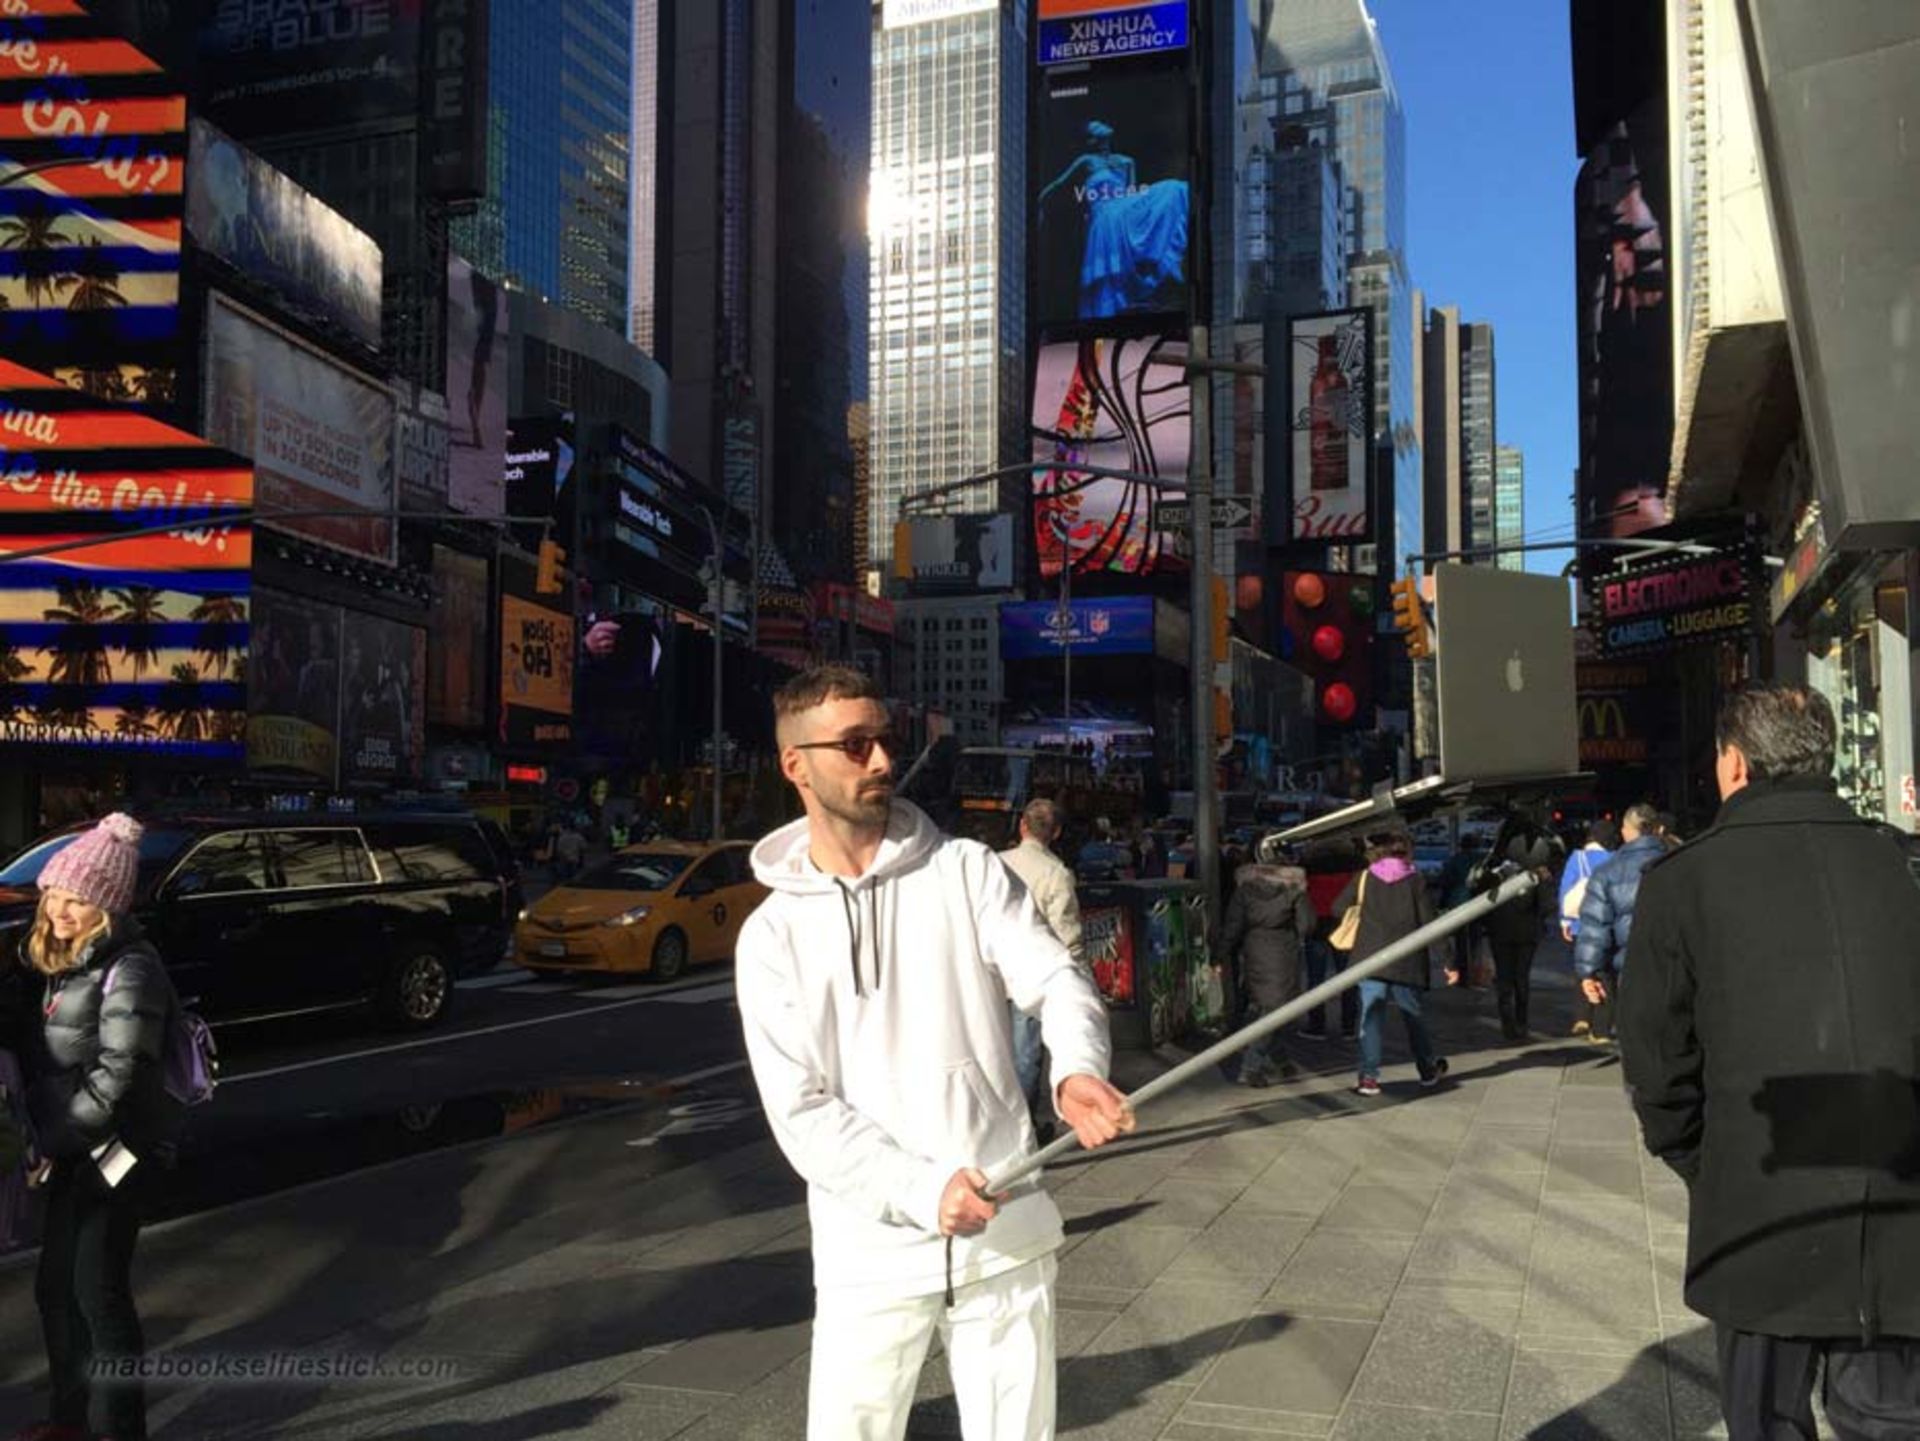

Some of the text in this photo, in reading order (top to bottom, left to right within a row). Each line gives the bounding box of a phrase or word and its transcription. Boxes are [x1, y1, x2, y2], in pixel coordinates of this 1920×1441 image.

[271, 5, 390, 50] BLUE
[1049, 29, 1177, 59] NEWS AGENCY
[1069, 13, 1157, 41] XINHUA
[1603, 560, 1744, 618] ELECTRONICS
[1607, 602, 1750, 648] CAMERA LUGGAGE
